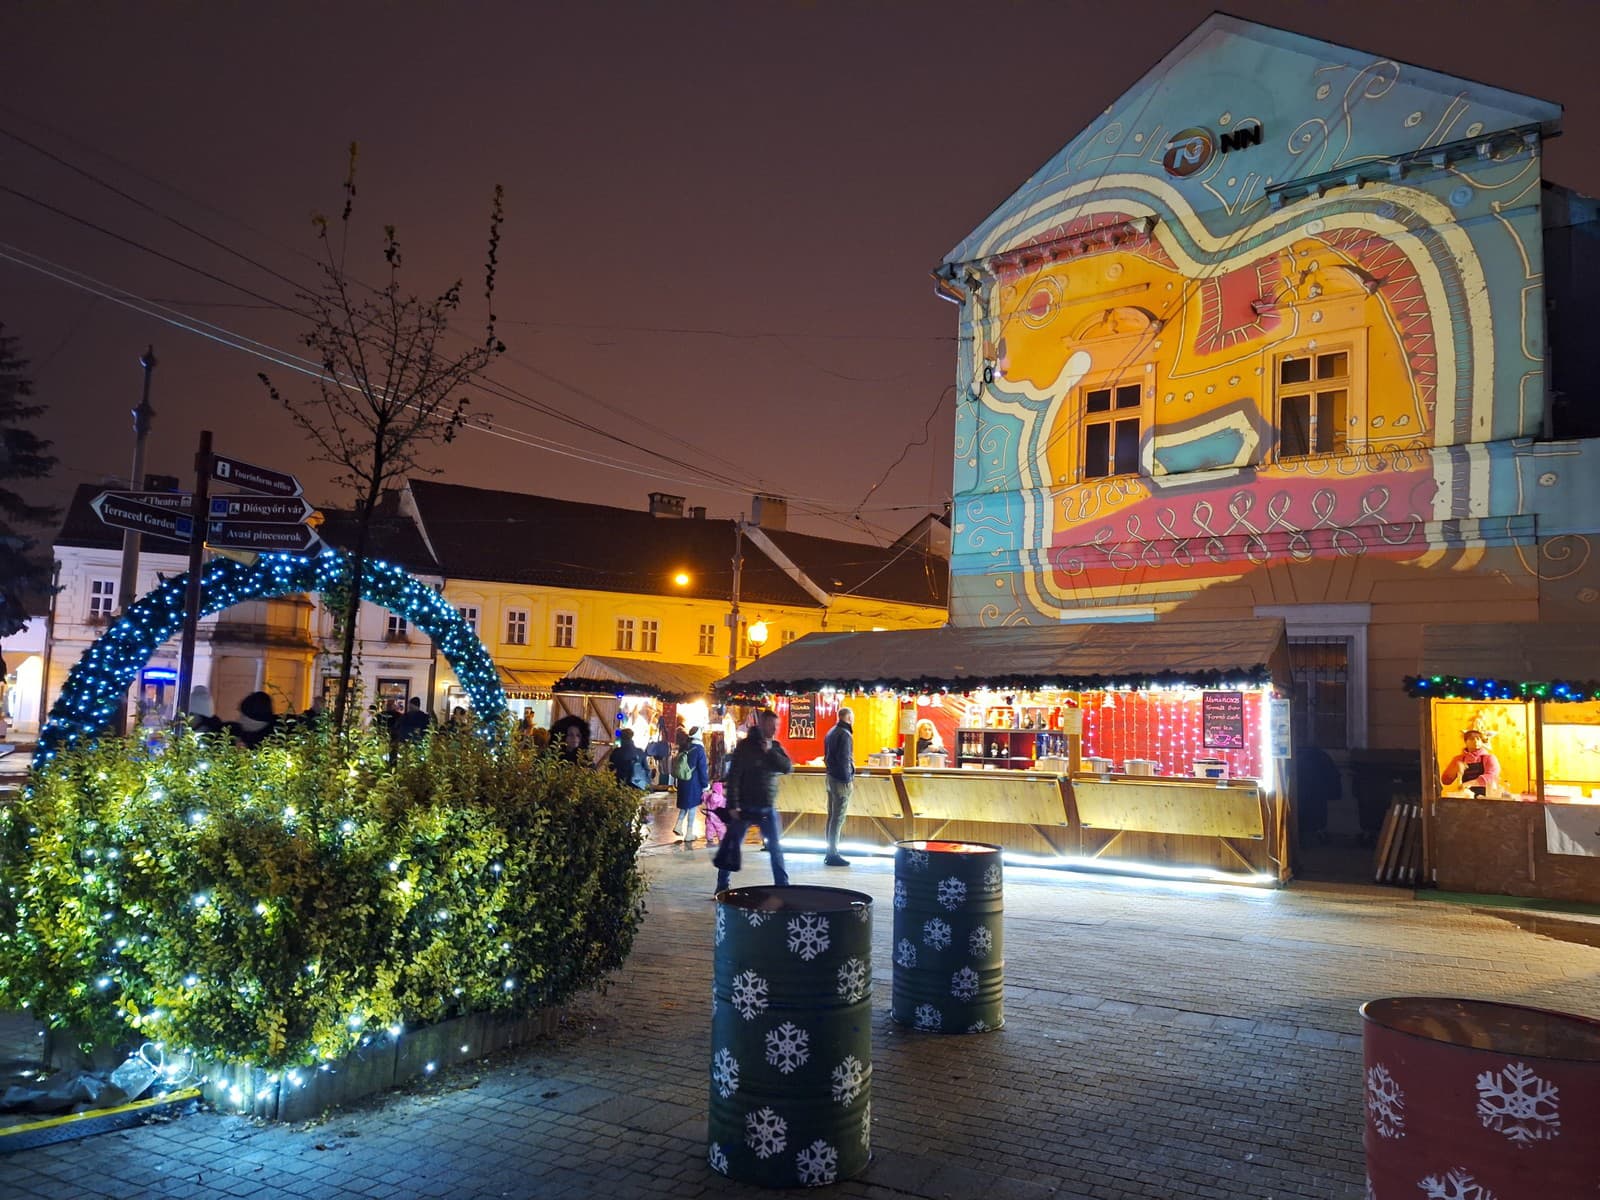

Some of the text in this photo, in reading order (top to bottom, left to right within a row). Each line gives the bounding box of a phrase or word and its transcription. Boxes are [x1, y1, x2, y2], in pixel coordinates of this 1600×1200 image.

[1220, 125, 1261, 153] NN
[150, 496, 180, 507] Theatre
[288, 504, 303, 513] vár
[103, 503, 175, 529] Terraced Garden
[227, 529, 302, 541] Avasi pincesorok
